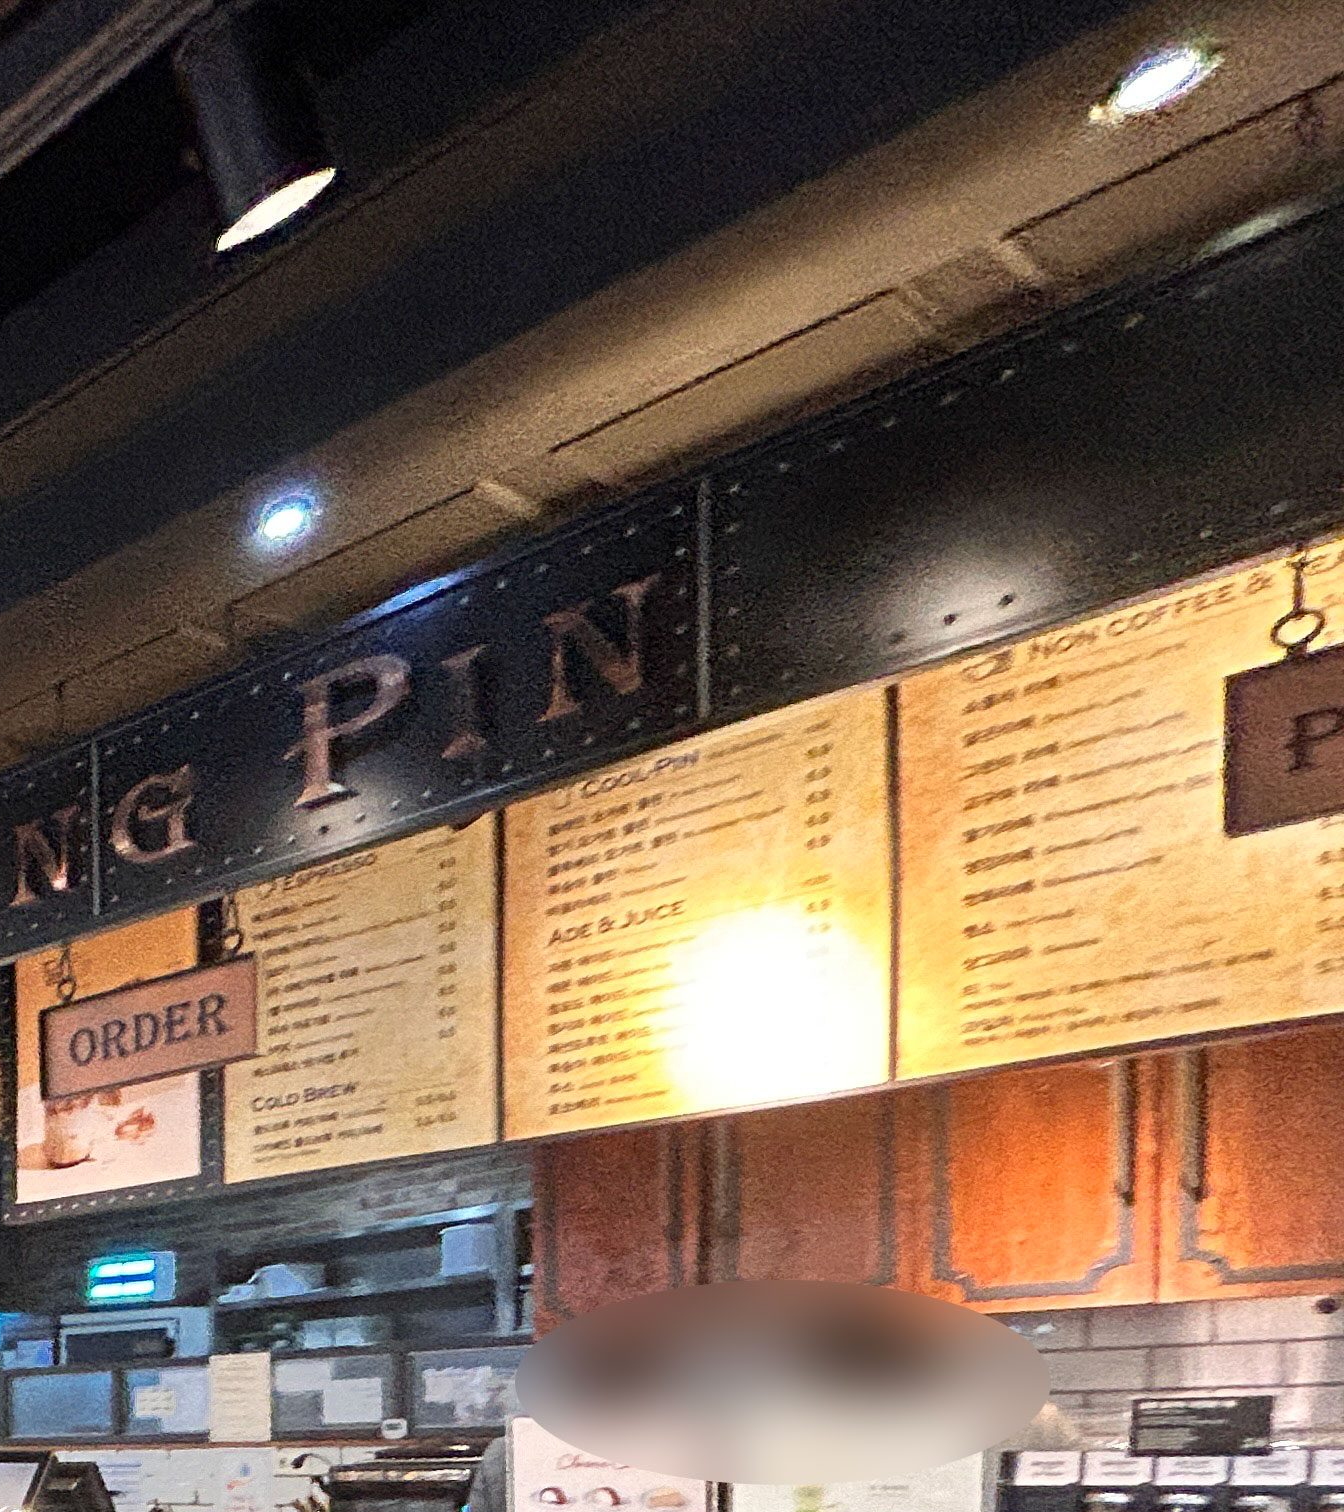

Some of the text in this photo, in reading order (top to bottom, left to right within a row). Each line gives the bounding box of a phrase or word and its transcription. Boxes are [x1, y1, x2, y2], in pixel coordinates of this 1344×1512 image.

[1027, 623, 1098, 661] NON
[1105, 584, 1234, 638] COFFEE
[282, 574, 662, 810] PIN
[547, 922, 593, 946] ADE
[619, 900, 686, 929] JUICE
[68, 991, 231, 1068] ORDER
